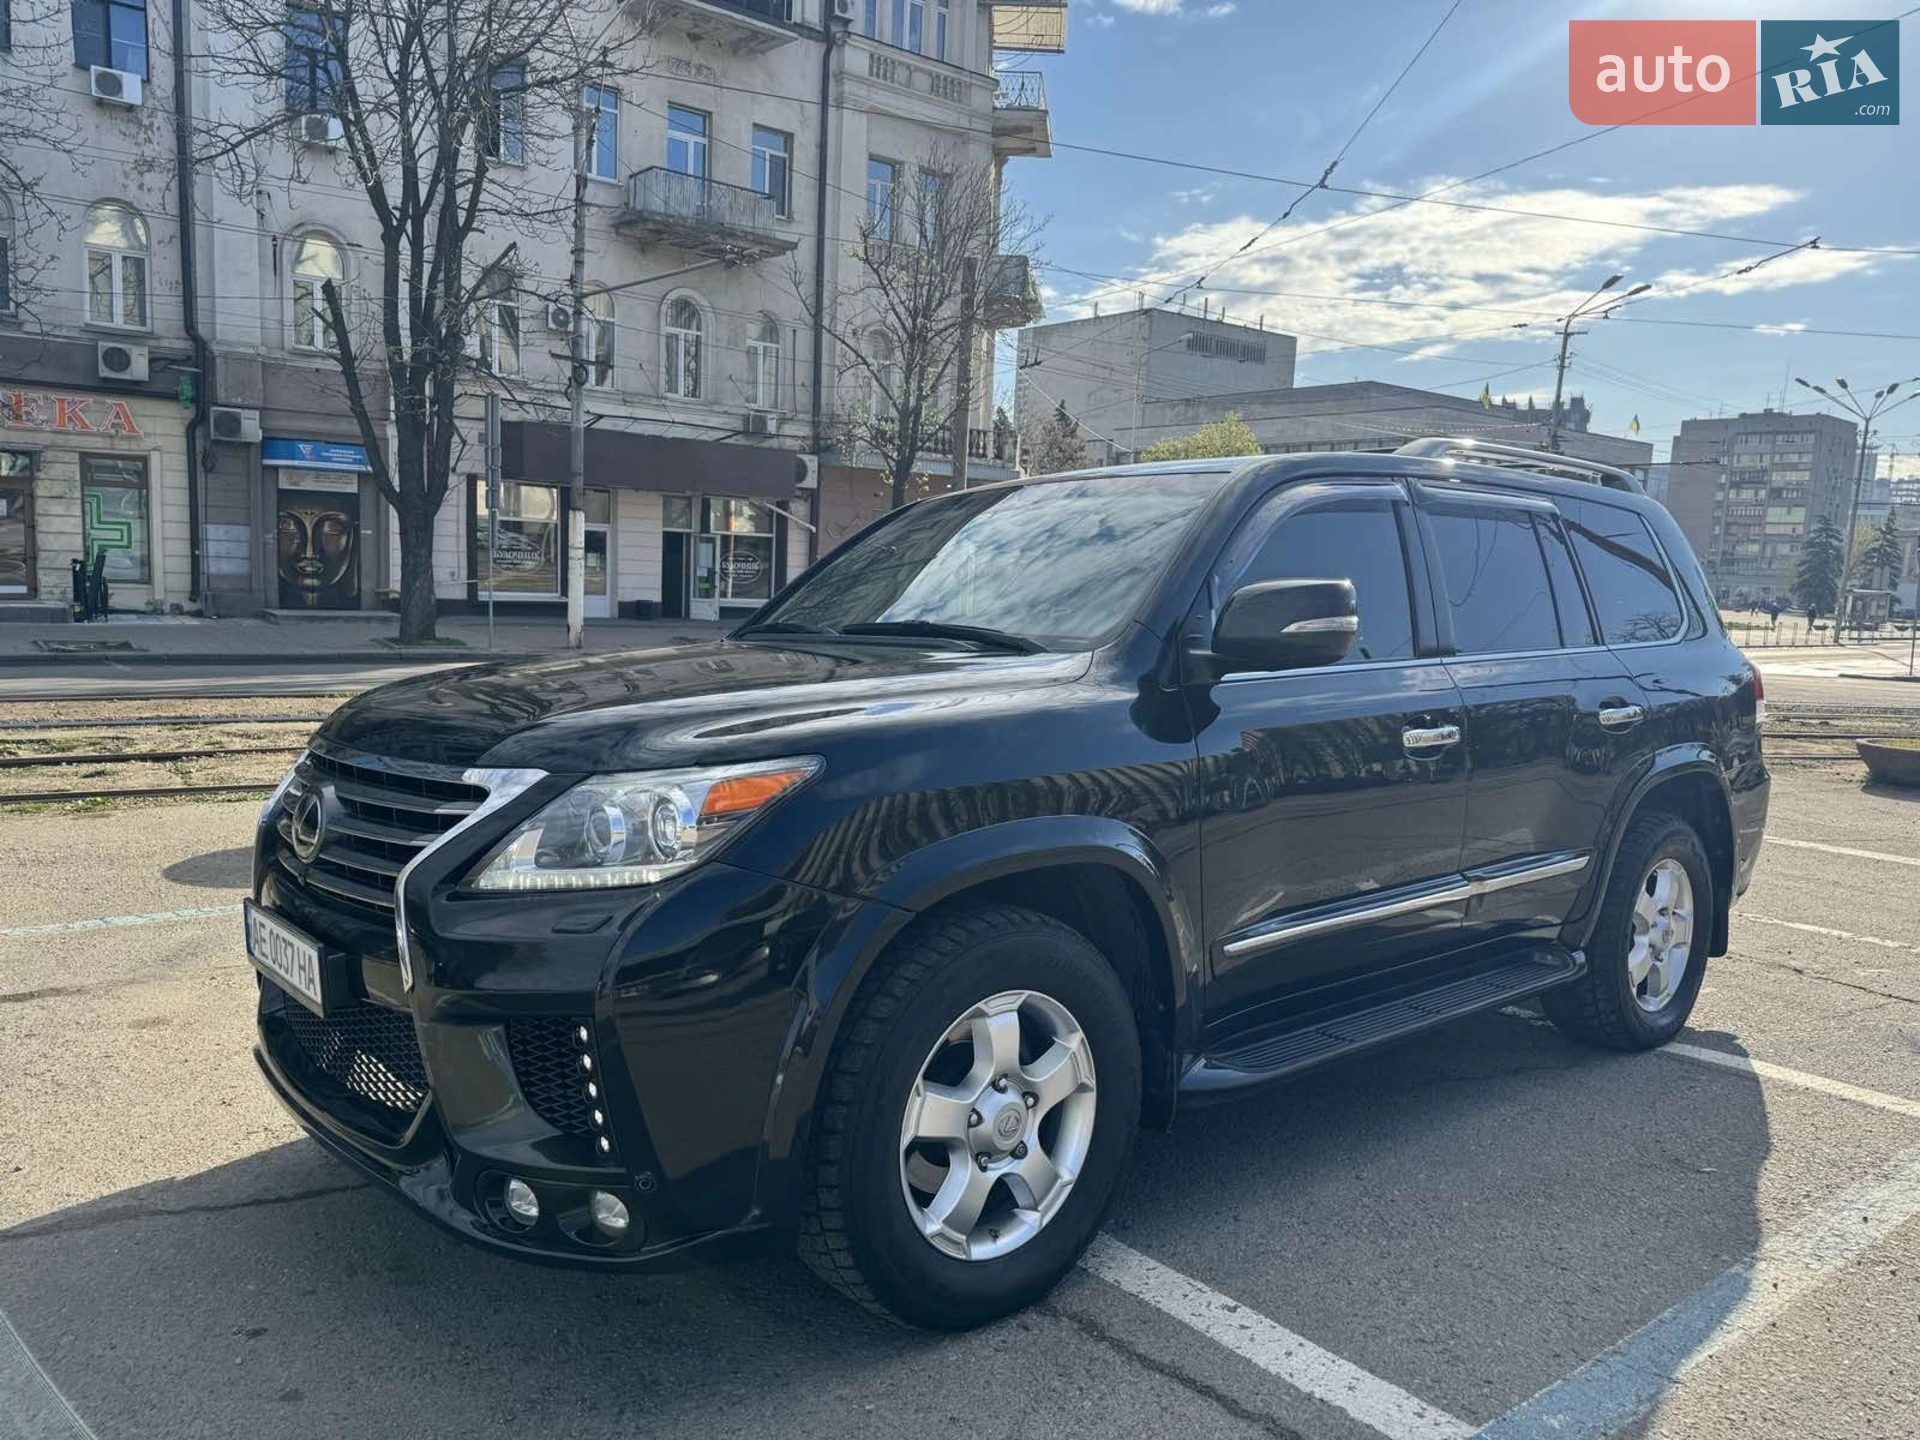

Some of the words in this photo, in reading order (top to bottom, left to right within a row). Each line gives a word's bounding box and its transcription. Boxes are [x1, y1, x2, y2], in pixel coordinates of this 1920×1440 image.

[250, 917, 269, 960] AE
[268, 928, 295, 978] 0037
[297, 946, 318, 996] HA
